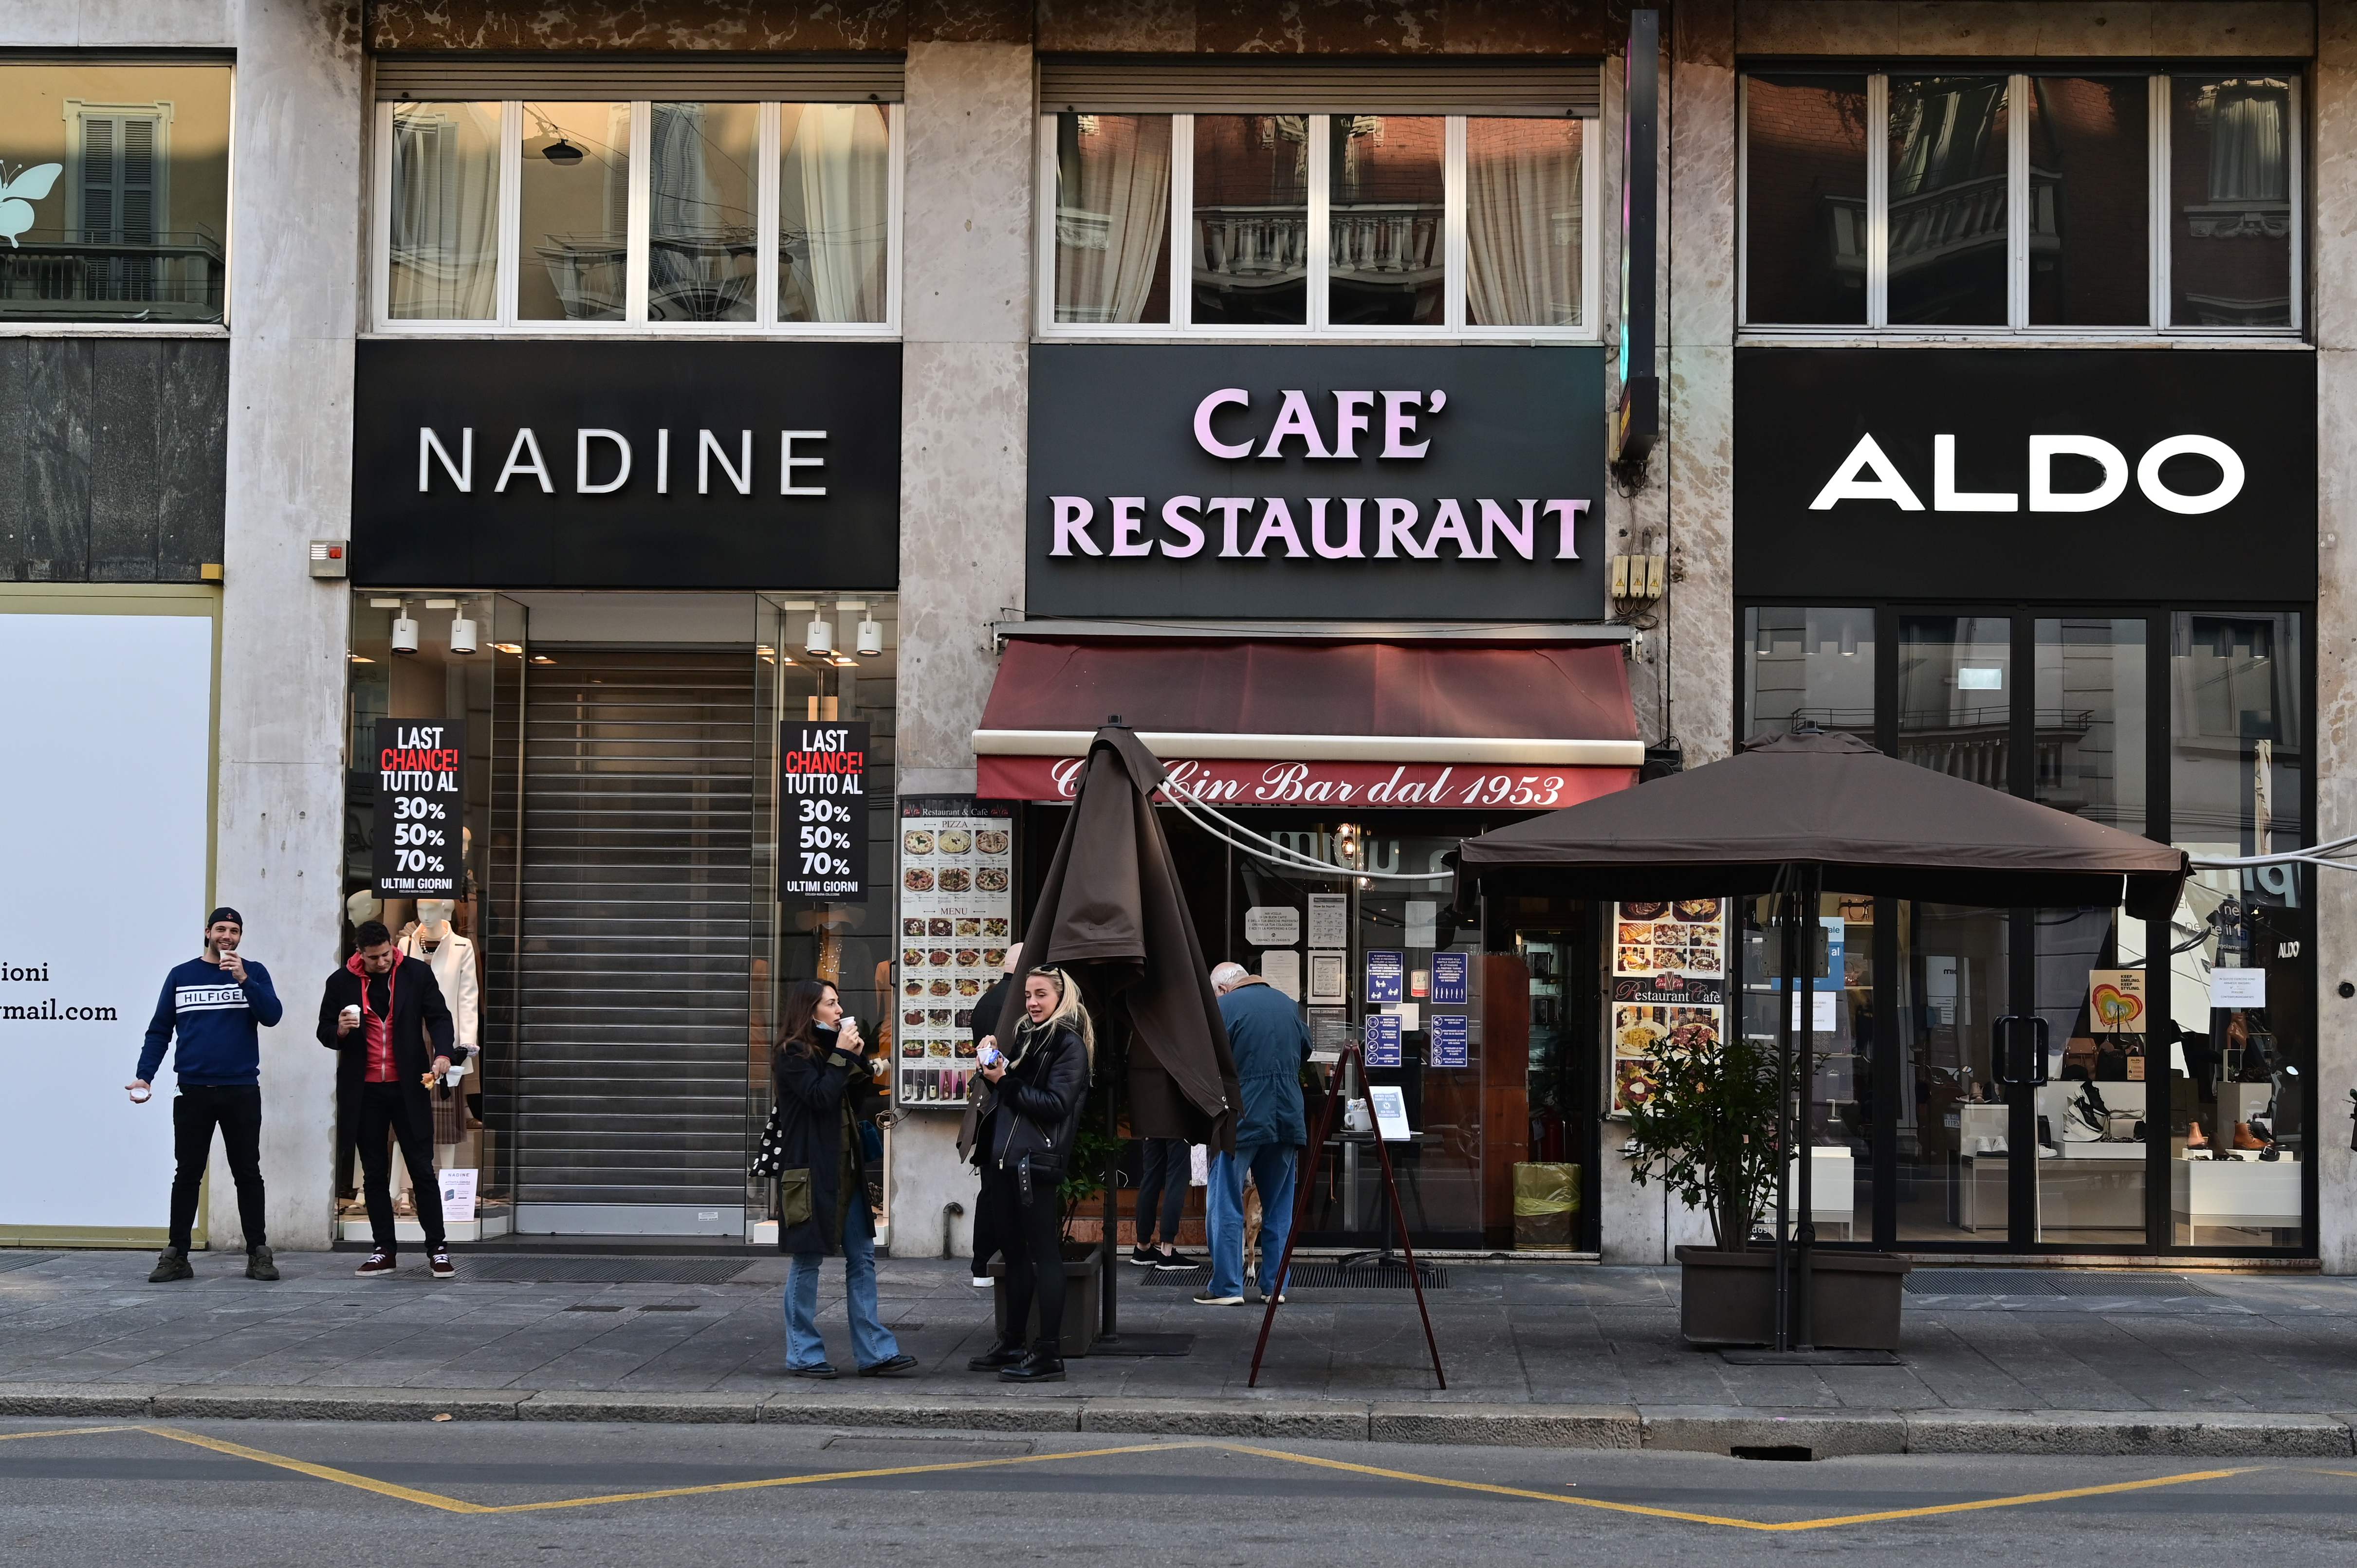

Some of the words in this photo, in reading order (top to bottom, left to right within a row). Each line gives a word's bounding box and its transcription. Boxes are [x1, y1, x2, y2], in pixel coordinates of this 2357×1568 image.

[419, 427, 828, 495] NADINE
[1808, 432, 2245, 515] ALDO
[1047, 495, 1591, 560] RESTAURANT
[398, 727, 443, 749] LAST
[802, 729, 848, 752] LAST
[381, 749, 458, 771] CHANCE!
[786, 751, 863, 774] CHANCE!
[381, 771, 433, 791] TUTTO
[437, 771, 458, 791] AL
[786, 773, 838, 794] TUTTO
[842, 774, 863, 794] AL
[1256, 762, 1364, 802] Bar
[1368, 766, 1454, 803] dal
[1459, 775, 1564, 805] 1953
[394, 797, 446, 820] 30%
[799, 800, 850, 822] 30%
[394, 823, 445, 846] 50%
[800, 826, 850, 849] 50%
[395, 849, 444, 872] 70%
[800, 852, 850, 875] 70%
[381, 878, 415, 889] ULTIMI
[417, 878, 452, 890] GIORNI
[787, 881, 820, 892] ULTIMI
[823, 881, 858, 892] GIORNI
[2278, 941, 2301, 958] ALDO
[1, 962, 49, 981] ioni
[1616, 980, 1689, 1002] Restaurant
[0, 998, 117, 1021] mail.com
